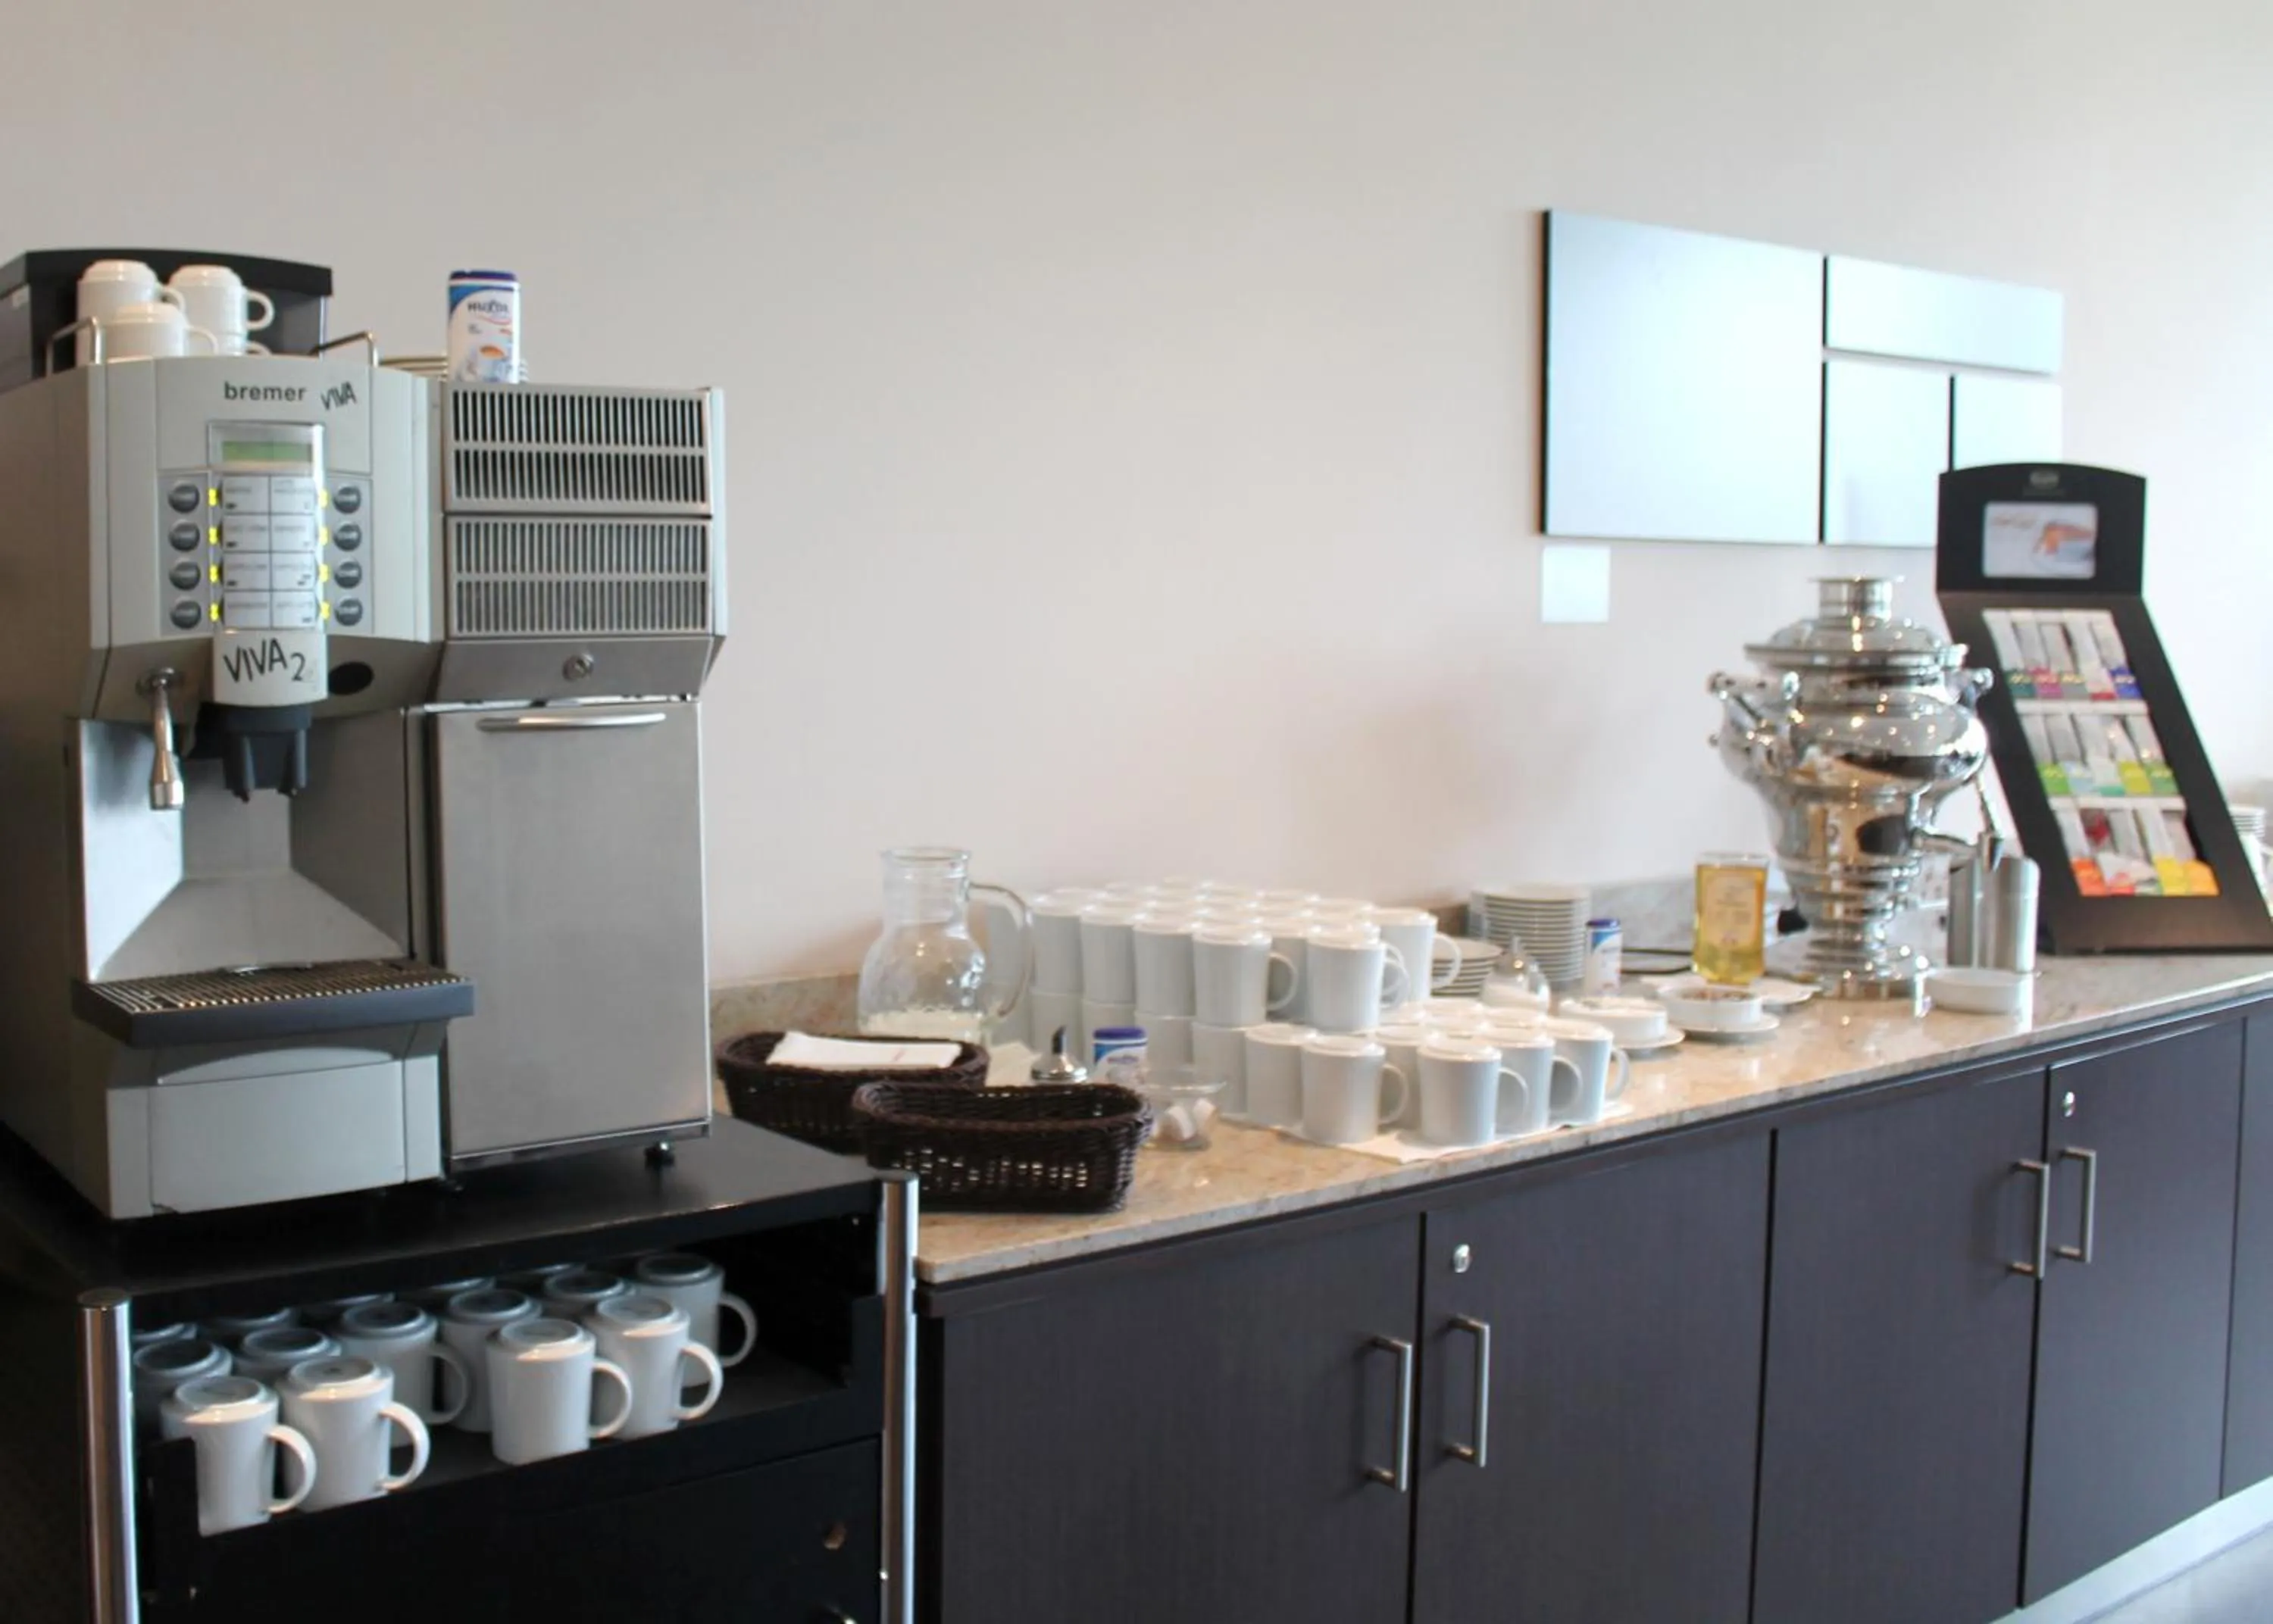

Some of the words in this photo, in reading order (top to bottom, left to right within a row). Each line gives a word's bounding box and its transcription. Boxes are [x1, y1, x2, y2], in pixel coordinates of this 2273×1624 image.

[224, 380, 305, 401] bremer
[320, 380, 358, 411] VIVA
[223, 636, 288, 682] VIVA
